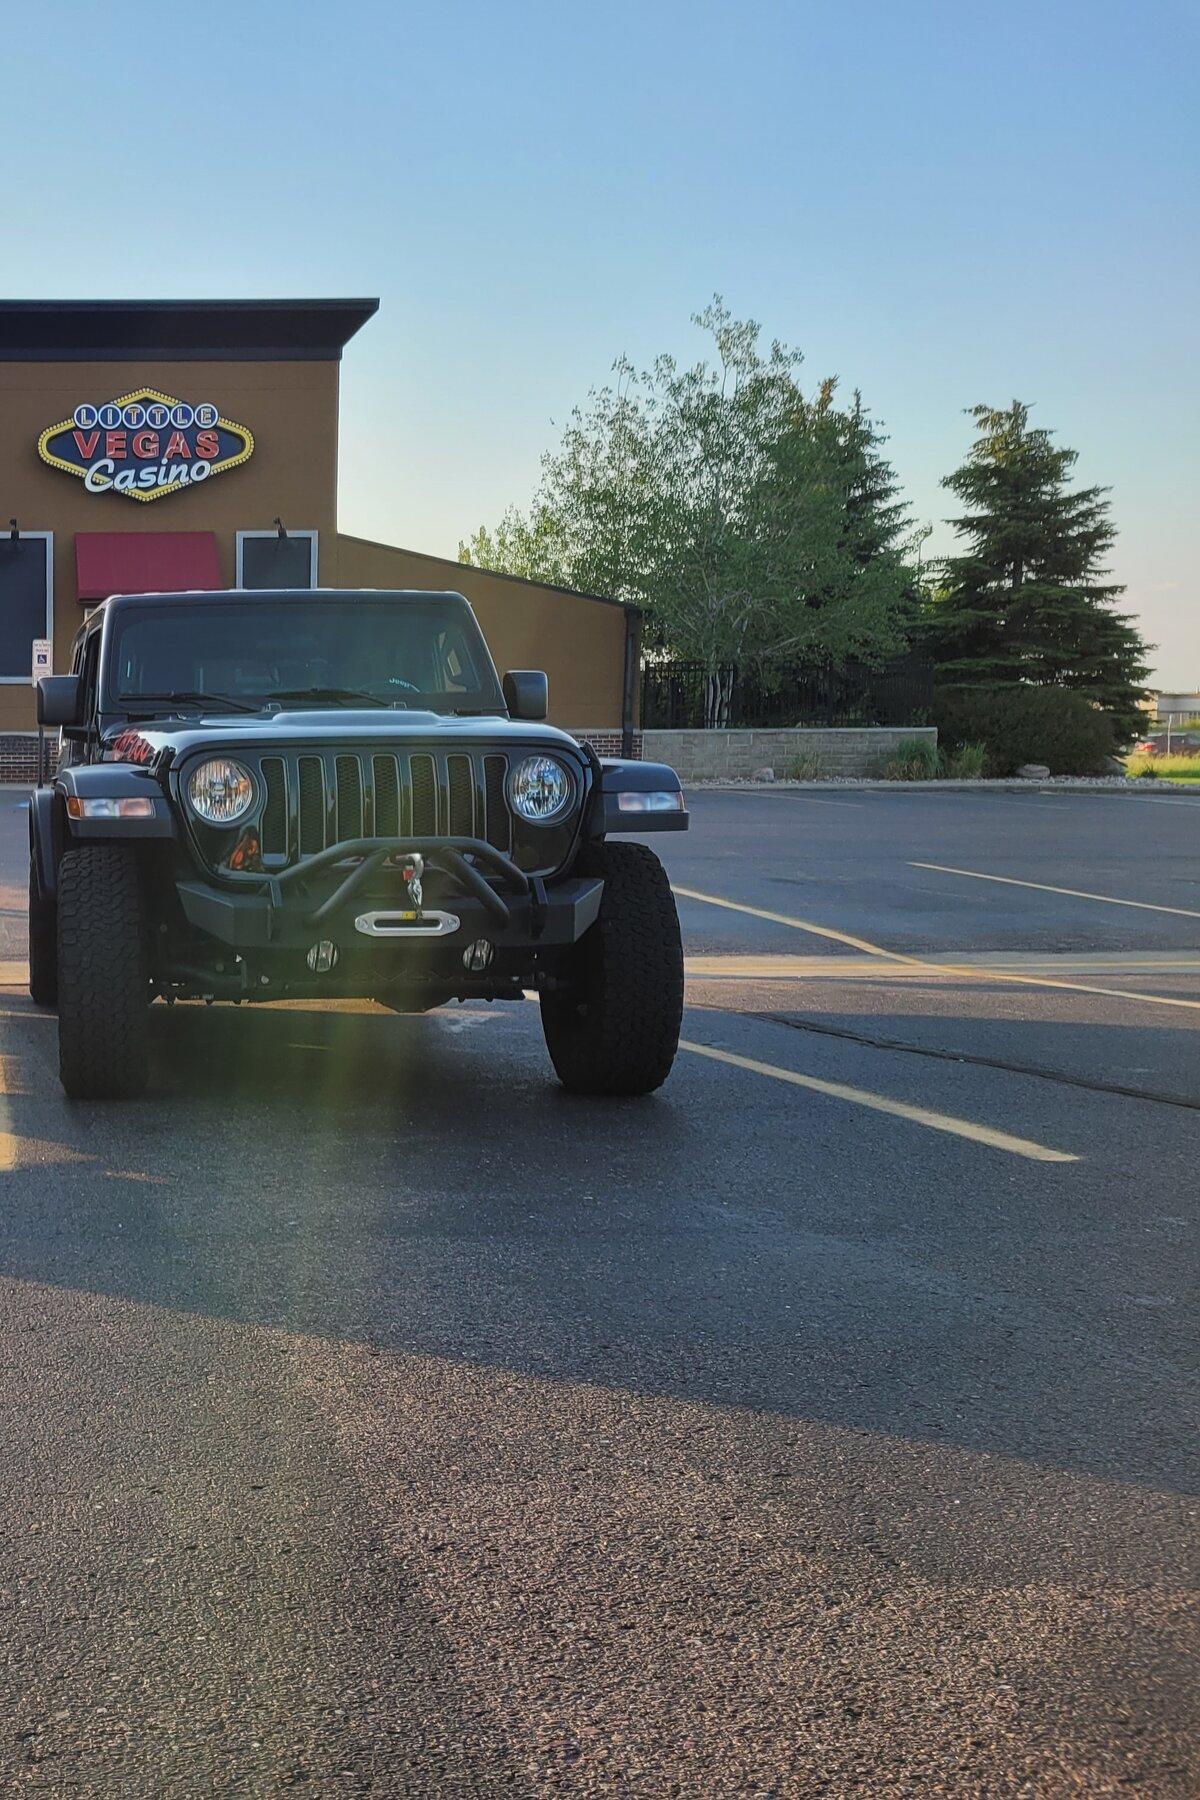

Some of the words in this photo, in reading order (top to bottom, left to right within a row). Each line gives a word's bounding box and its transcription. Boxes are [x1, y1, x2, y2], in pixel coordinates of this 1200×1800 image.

[77, 405, 215, 428] LITTLE
[72, 431, 220, 459] VEGAS
[84, 458, 212, 493] Casino
